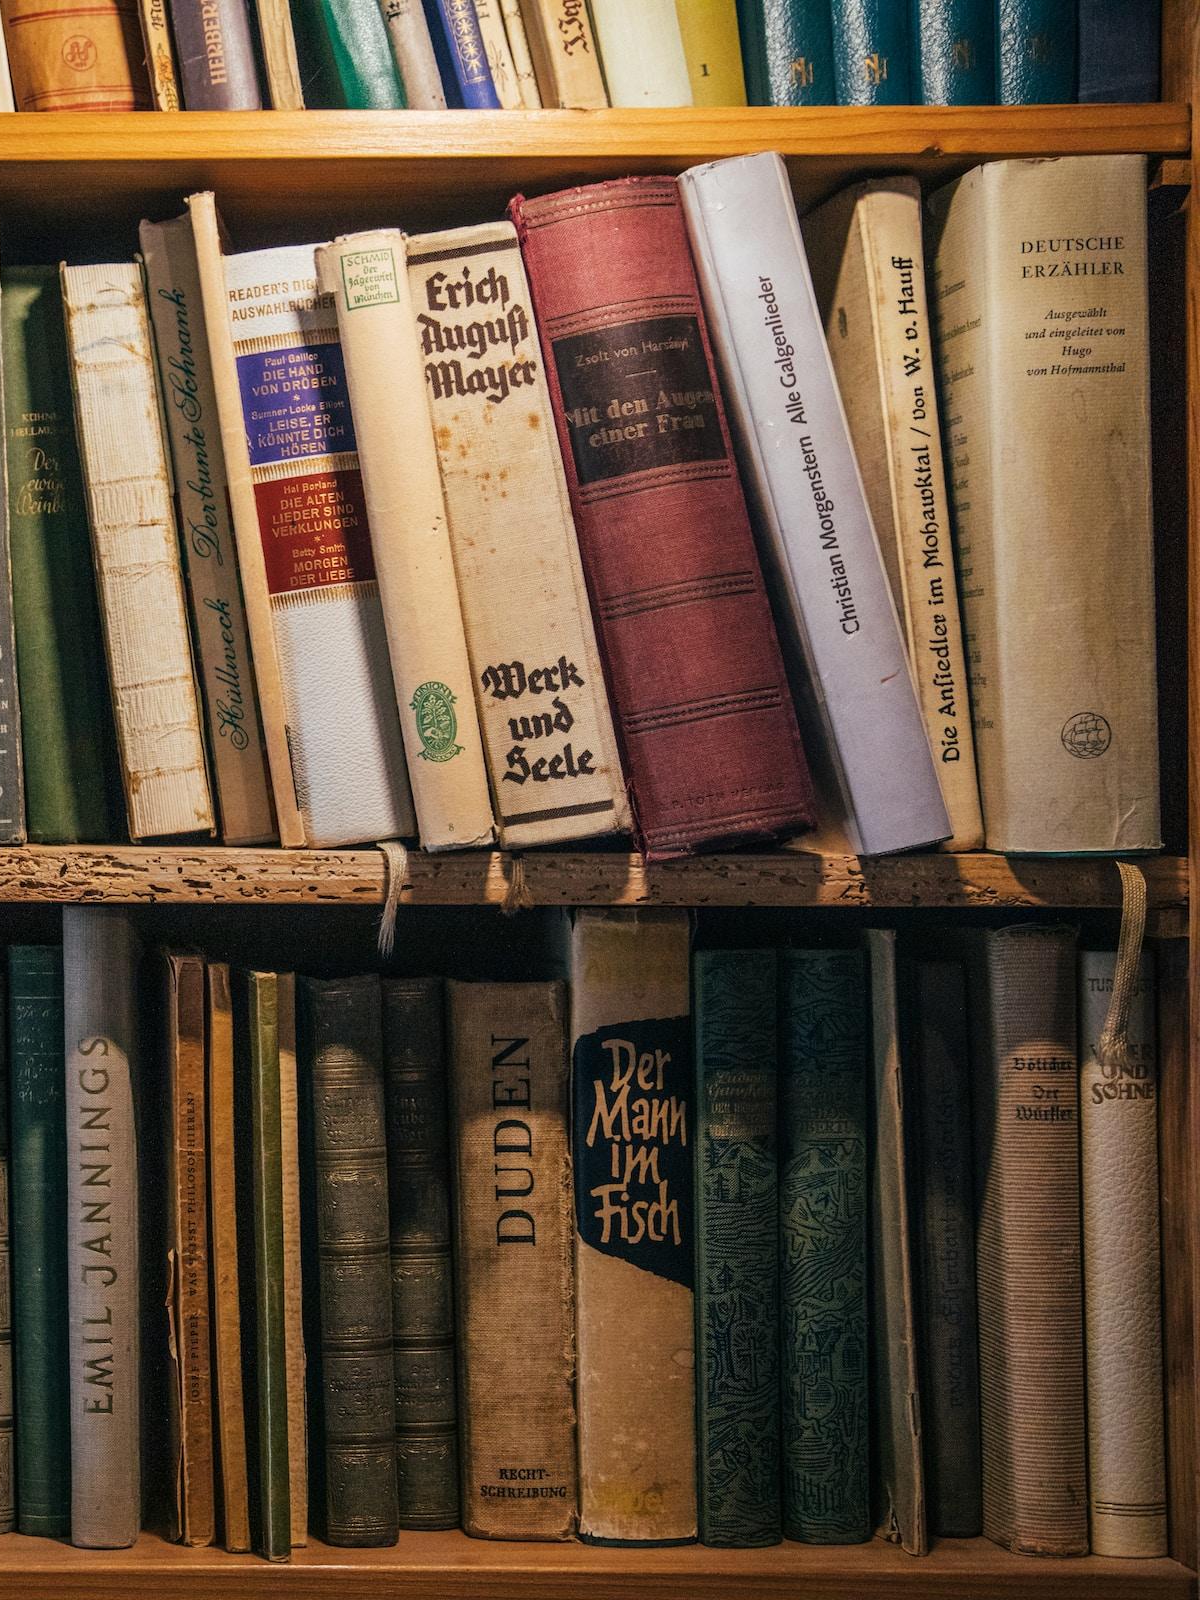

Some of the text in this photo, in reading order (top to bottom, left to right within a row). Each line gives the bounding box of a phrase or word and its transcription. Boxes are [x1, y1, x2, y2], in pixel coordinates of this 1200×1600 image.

[701, 63, 711, 77] 1
[1020, 236, 1126, 254] DEUTSCHE
[346, 252, 390, 267] SCHMID
[1021, 260, 1125, 279] ERZÄHLER
[353, 291, 393, 305] München
[425, 266, 510, 312] Erich
[232, 296, 337, 322] AUSWAHLBÜCHER
[1044, 308, 1108, 322] Ausgewählt
[1025, 327, 1126, 341] und eingeleitet von
[575, 347, 638, 368] Zsolt von
[1061, 345, 1092, 358] Hugo
[264, 356, 285, 367] Paul
[1026, 362, 1126, 377] von Hofmannsthal
[263, 364, 324, 381] DIE HAND
[424, 357, 537, 404] Mayer
[251, 384, 279, 397] VON
[251, 403, 317, 420] Sumner Locke
[564, 398, 650, 428] Mit den
[158, 286, 224, 567] Der bunte Schrank
[269, 413, 331, 432] LEISE, ER
[588, 412, 705, 448] einer Frau
[258, 425, 345, 448] KÖNNTE DICH
[281, 441, 327, 457] HÖREN
[757, 275, 860, 635] Christian Morgenstern Alle Galgenlieder
[283, 479, 337, 495] Hal Borland
[280, 491, 344, 510] DIE ALTEN
[892, 256, 960, 764] Die im von W. Hauff
[272, 503, 354, 525] LIEDER SIND
[271, 516, 359, 539] VERKLUNGEN
[292, 543, 346, 559] Betty Smith
[294, 556, 348, 573] MORGEN
[290, 568, 356, 587] DER LIEBE
[481, 656, 585, 700] Werk
[415, 682, 450, 700] UNION
[507, 696, 575, 742] und
[502, 743, 597, 786] Seele
[601, 1038, 672, 1093] Der
[1032, 1085, 1059, 1099] Der
[585, 1079, 687, 1148] Mann
[490, 1033, 536, 1247] DUDEN
[611, 1142, 662, 1190] im
[590, 1178, 682, 1246] Fisch
[78, 1038, 118, 1416] EMIL JANNINGS
[188, 1271, 199, 1359] PIEPER WAS
[499, 1468, 550, 1481] RECHT-
[480, 1485, 567, 1498] SCHREIBUNG
